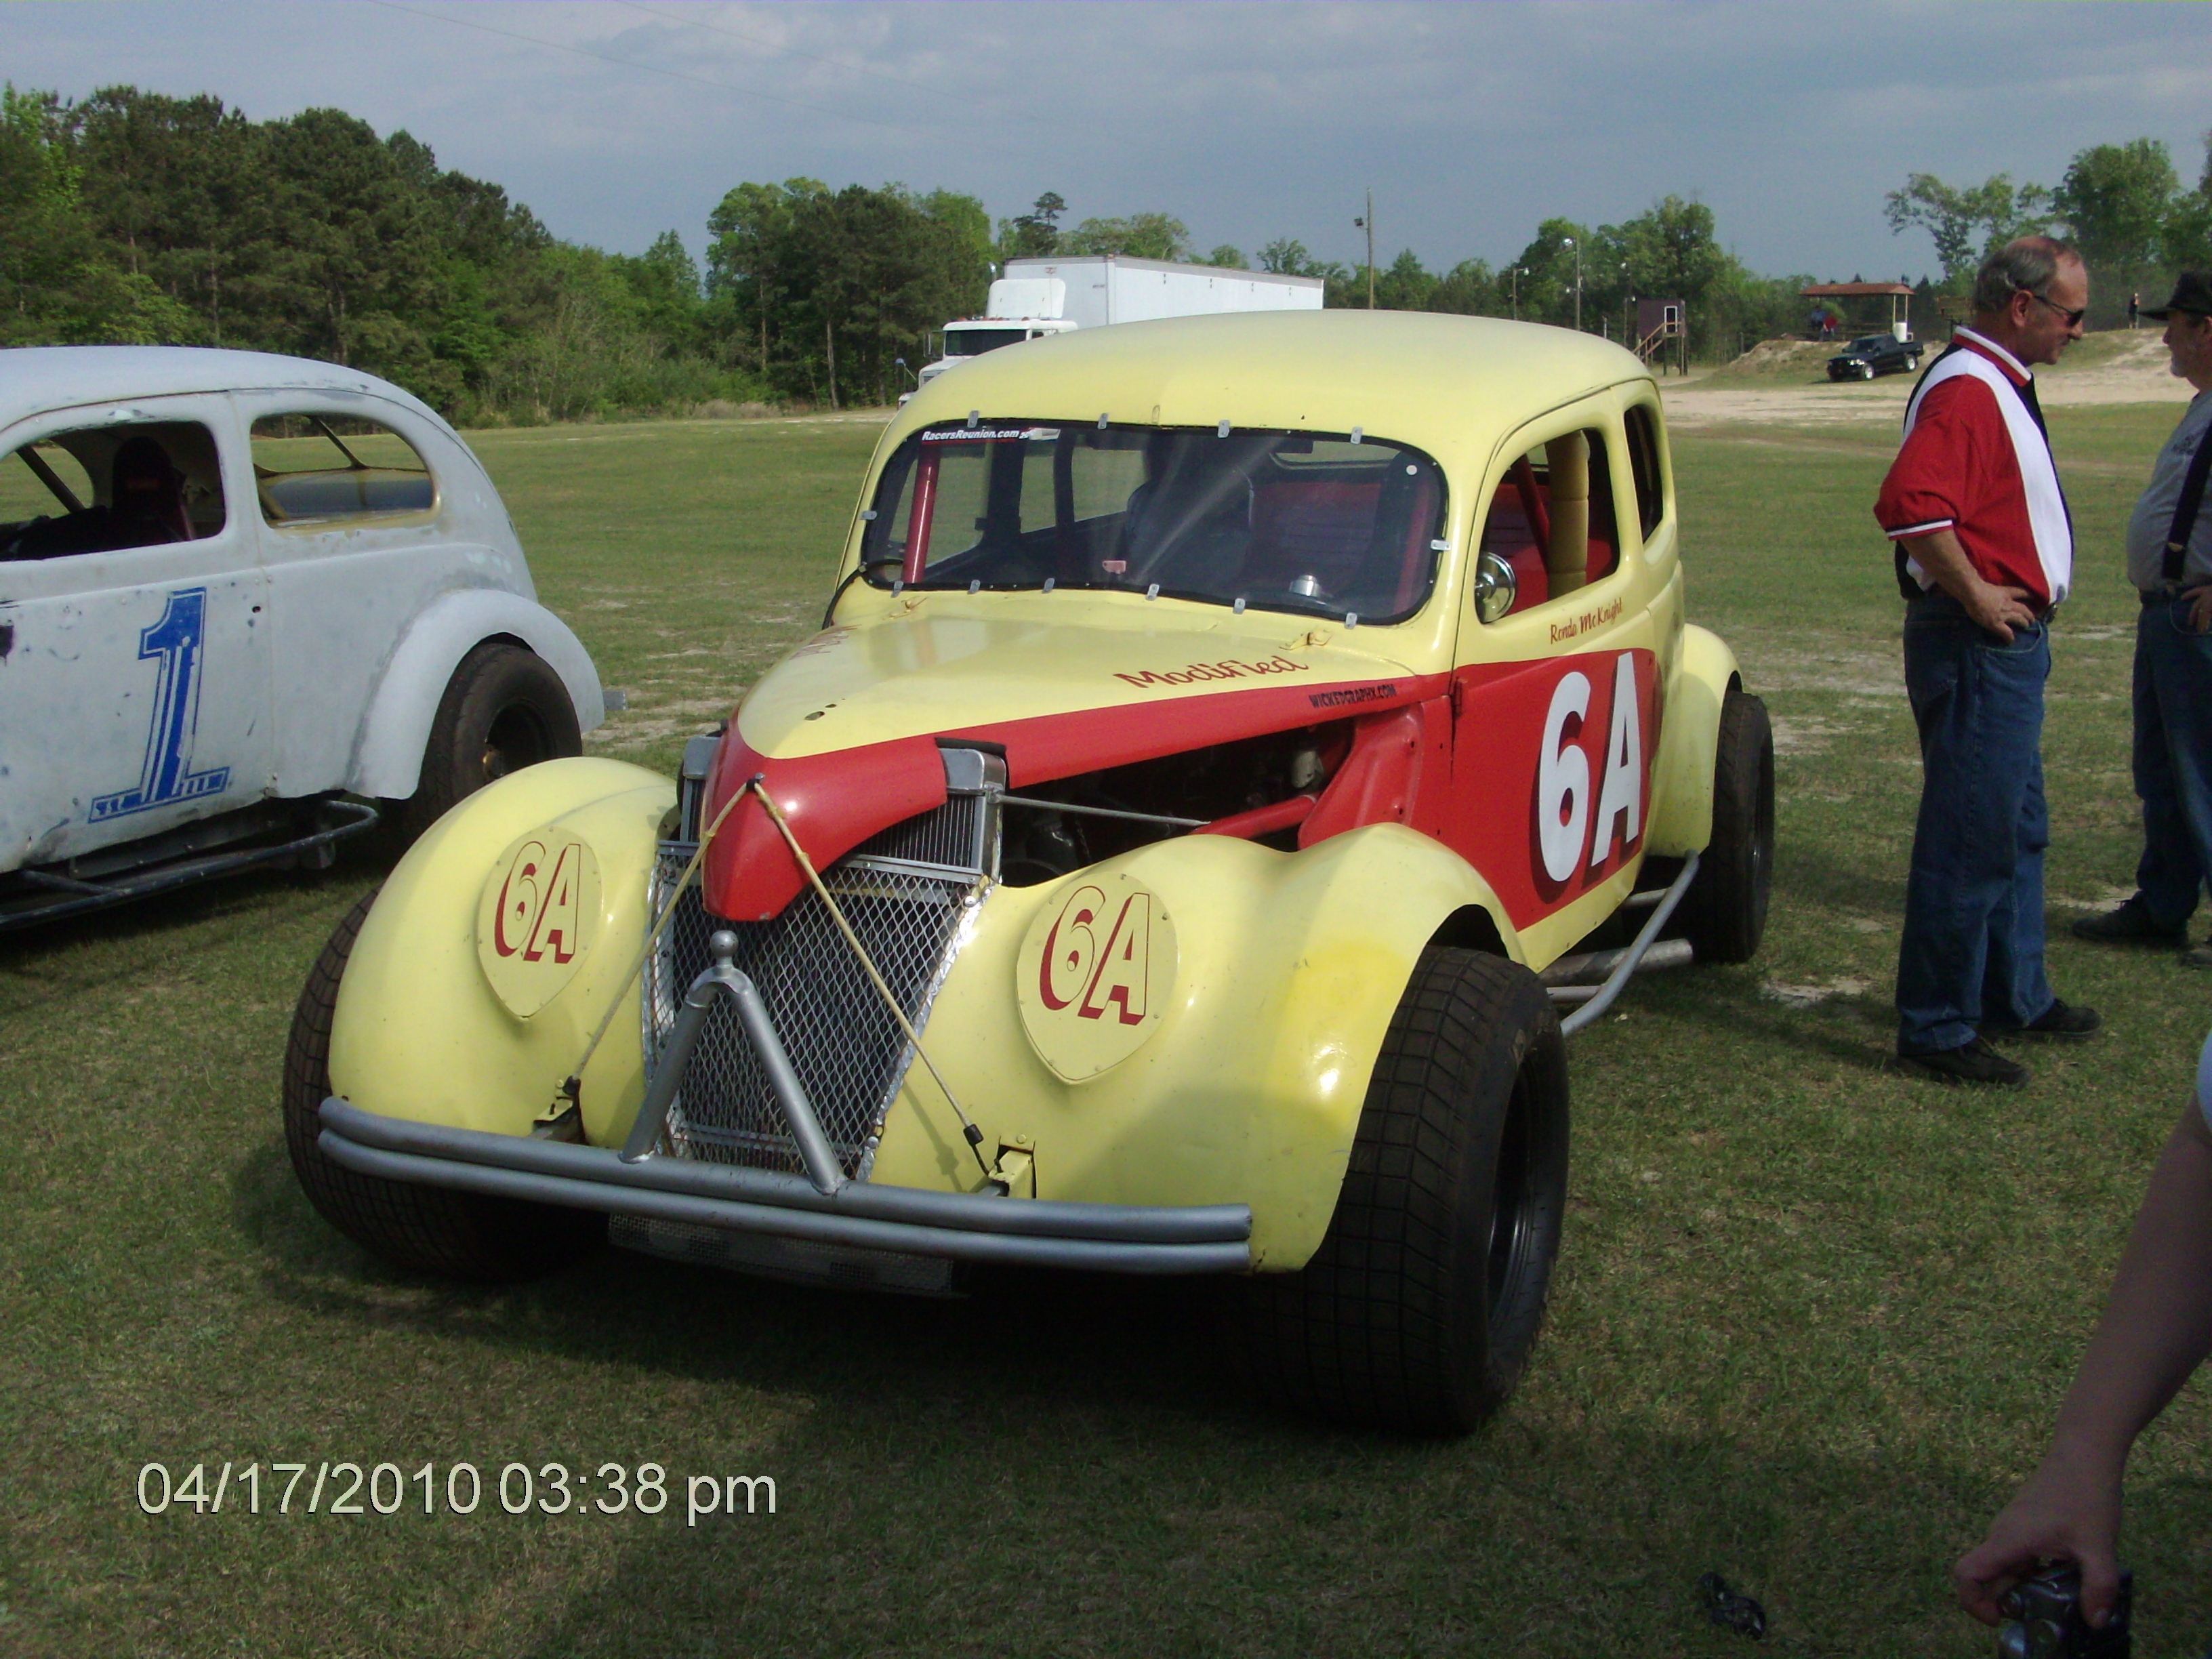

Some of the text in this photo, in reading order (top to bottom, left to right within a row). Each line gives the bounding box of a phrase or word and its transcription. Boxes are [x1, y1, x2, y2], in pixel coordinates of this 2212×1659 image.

[922, 428, 1019, 441] RacersReunion.com
[1113, 655, 1309, 689] Modified
[1551, 618, 1577, 644] Ronda
[88, 586, 229, 823] 1
[1537, 651, 1641, 884] 6A
[494, 840, 581, 964] 6A
[1039, 885, 1150, 1026] 6A
